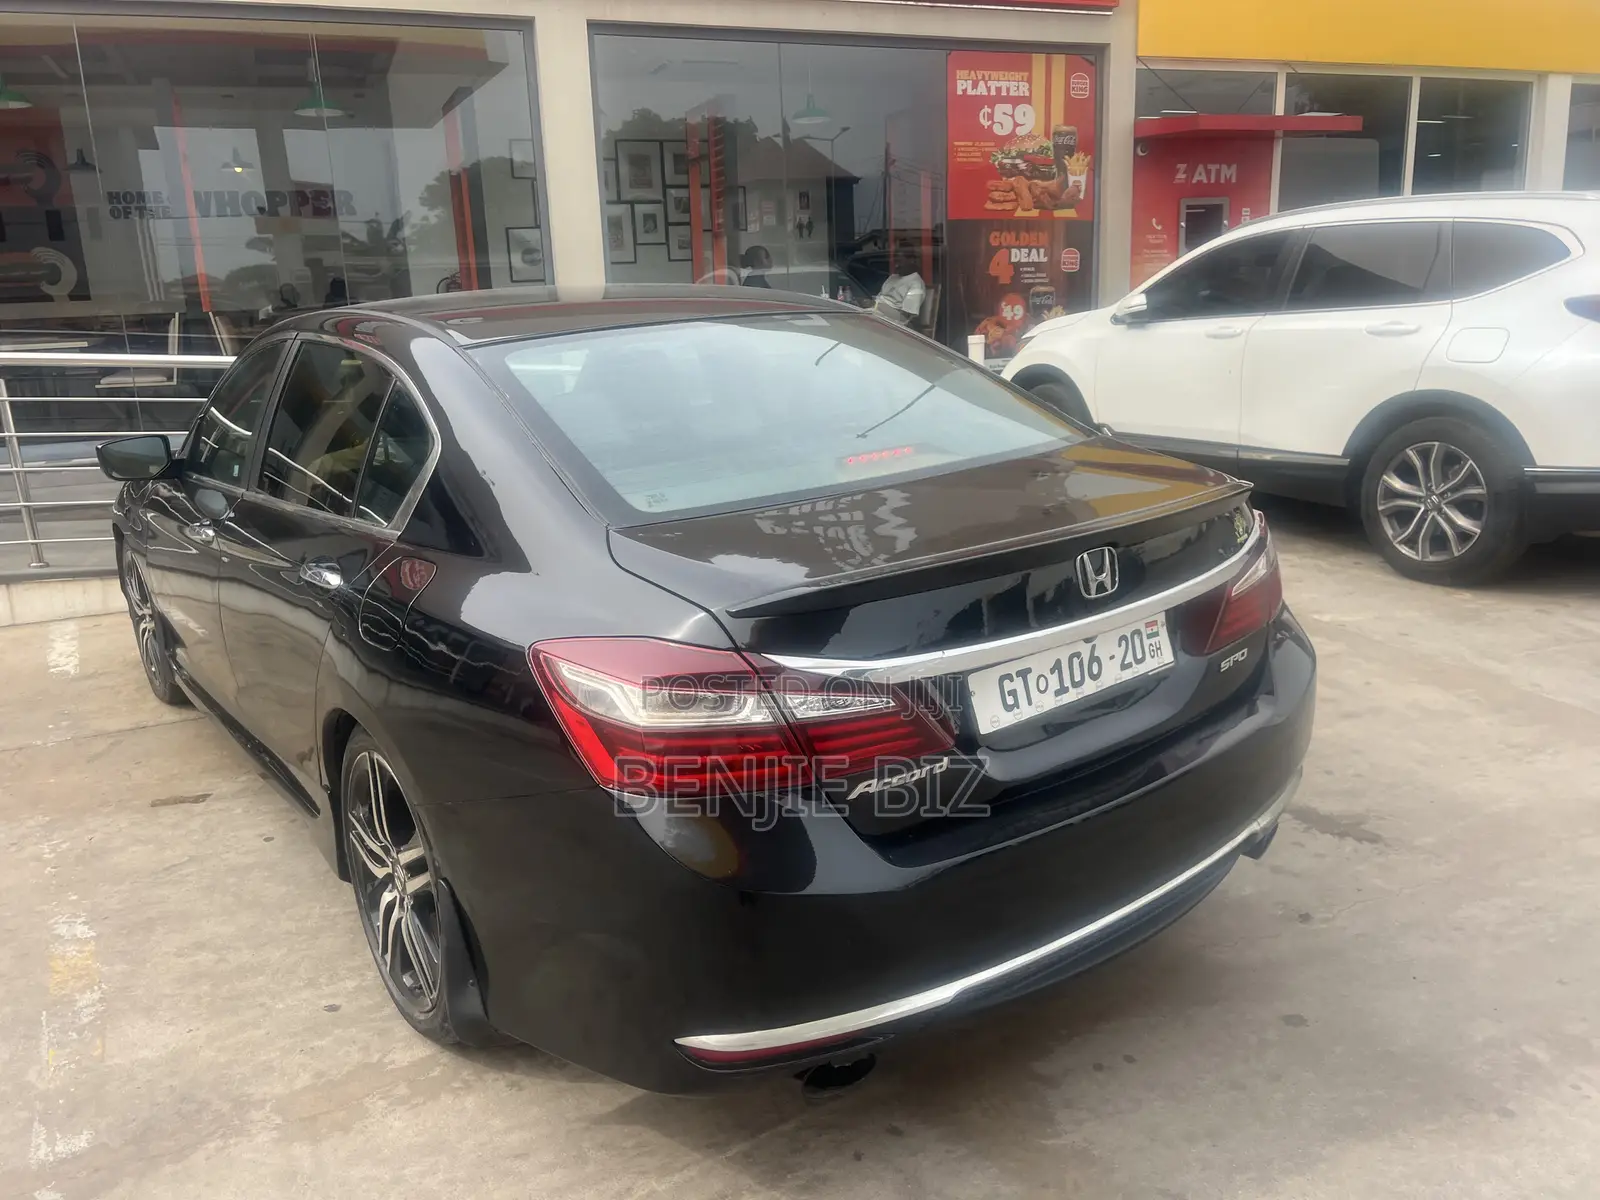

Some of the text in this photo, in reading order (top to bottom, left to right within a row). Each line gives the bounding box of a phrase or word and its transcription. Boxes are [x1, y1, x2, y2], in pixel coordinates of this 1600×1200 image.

[956, 70, 1029, 80] HEAVYWEIGHT
[956, 80, 1030, 96] PLATTER
[1192, 164, 1237, 183] ATM
[107, 191, 164, 205] HOME
[109, 206, 132, 219] OF
[989, 231, 1048, 246] GOLDEN
[988, 248, 1047, 284] 4 DEAL
[1148, 641, 1163, 659] GH
[846, 757, 949, 800] Accord
